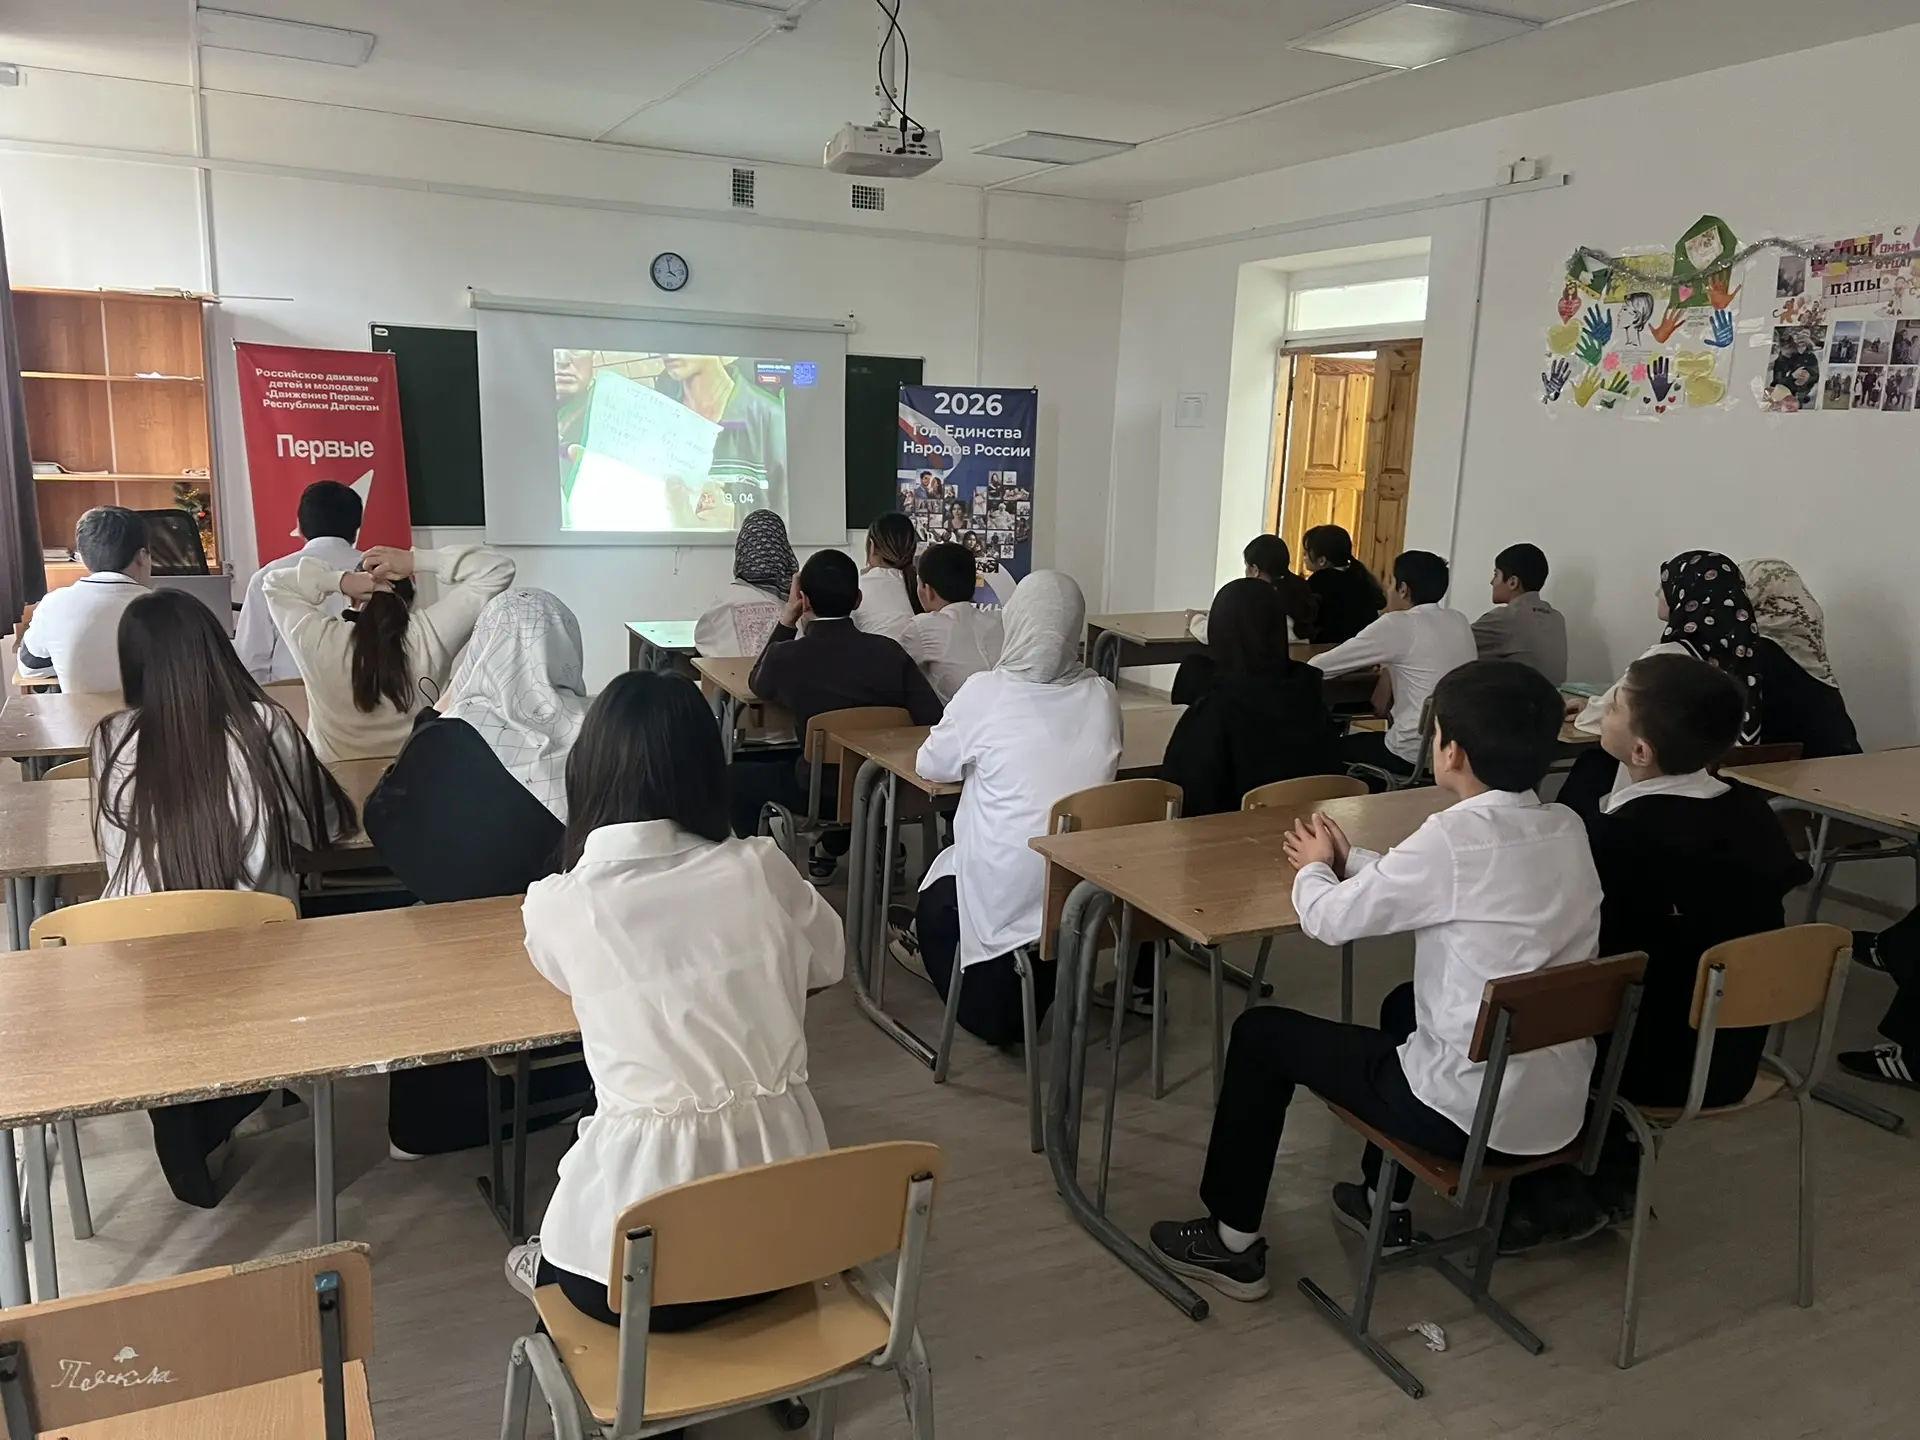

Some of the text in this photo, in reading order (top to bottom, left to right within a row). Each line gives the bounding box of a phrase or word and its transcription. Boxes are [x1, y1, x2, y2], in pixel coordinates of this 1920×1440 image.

[1830, 278, 1881, 296] папы
[255, 368, 379, 383] Российское движение
[269, 380, 303, 389] детей
[313, 383, 369, 392] молодежи
[263, 399, 380, 411] Республики Дагестан
[934, 392, 1003, 416] 2026
[912, 423, 1022, 439] Год Единства
[276, 434, 375, 465] Первые
[903, 441, 1031, 457] Народов России
